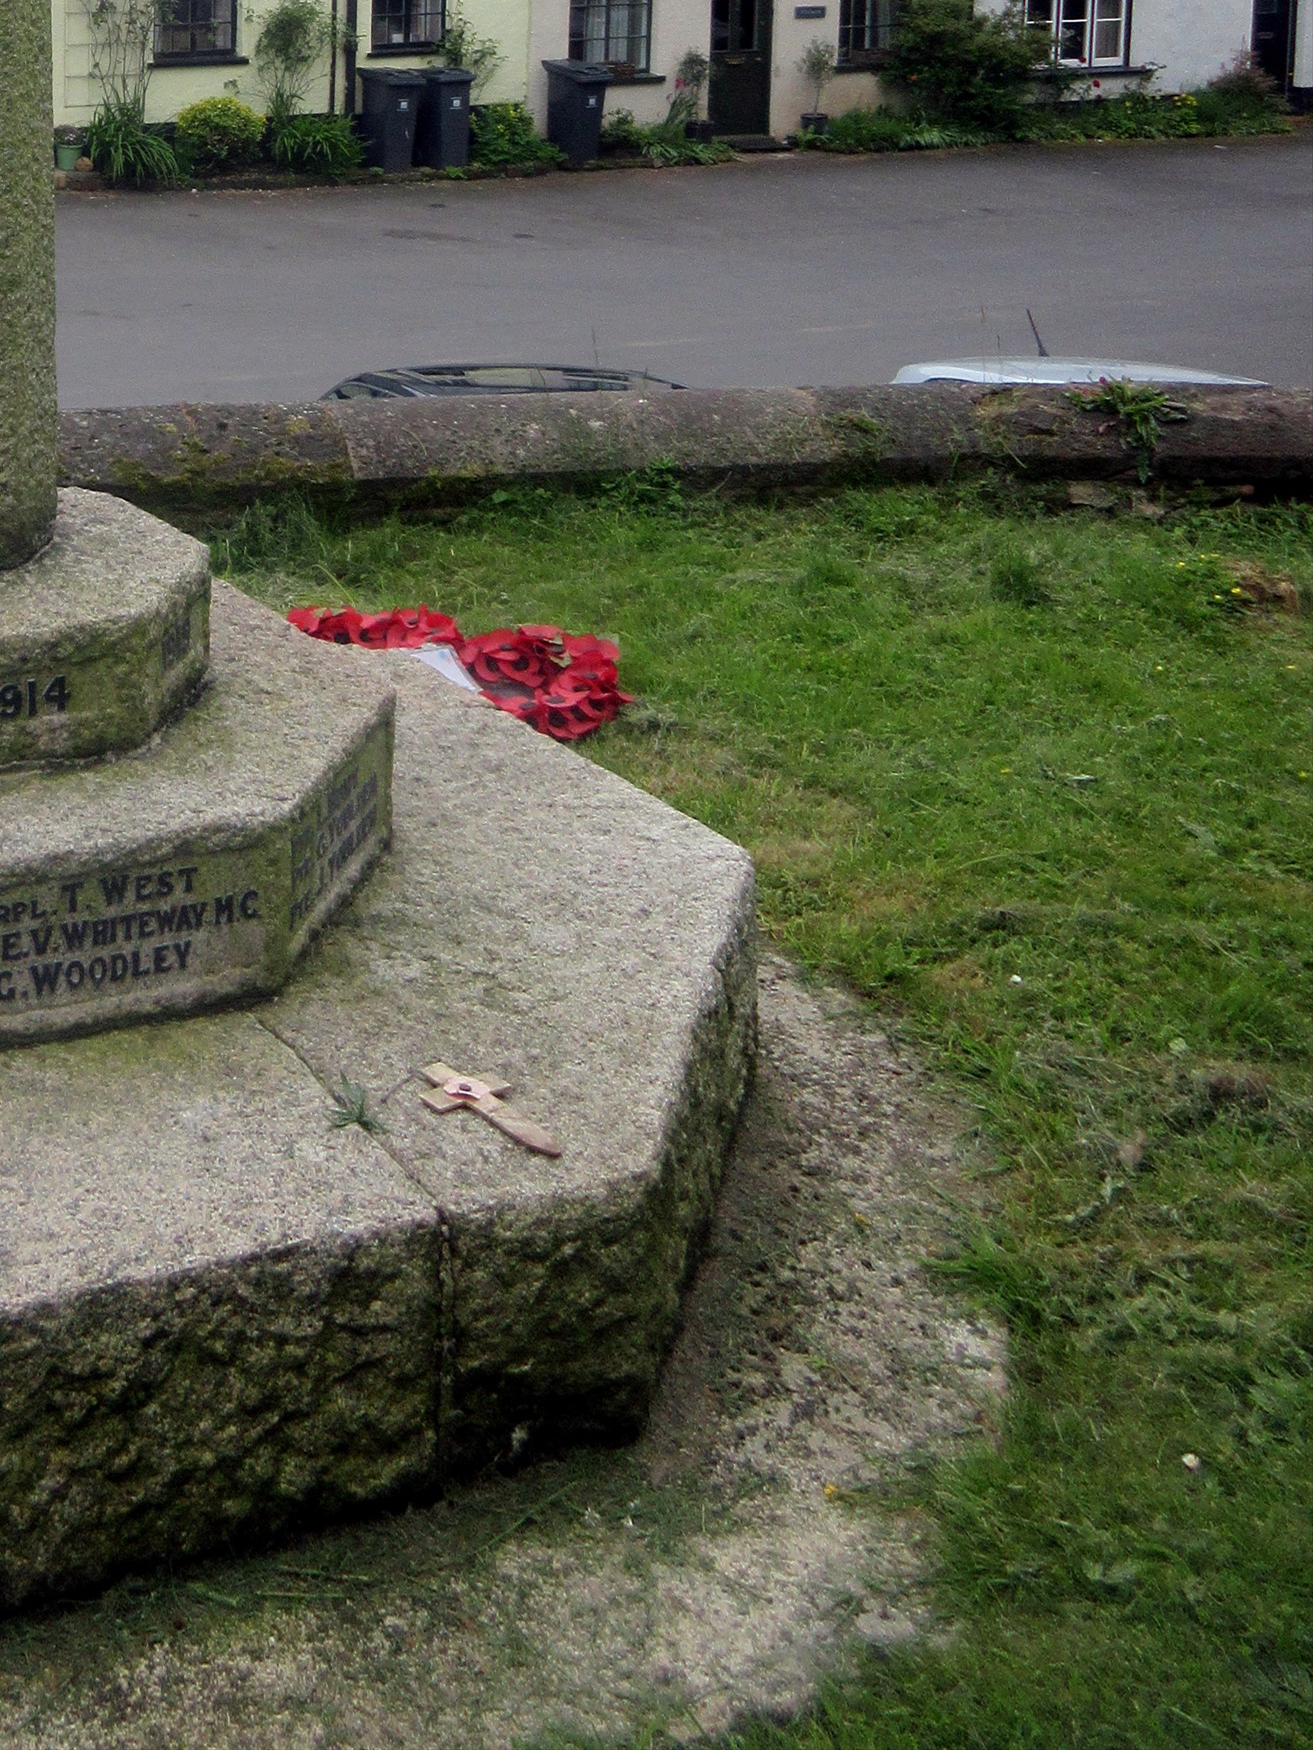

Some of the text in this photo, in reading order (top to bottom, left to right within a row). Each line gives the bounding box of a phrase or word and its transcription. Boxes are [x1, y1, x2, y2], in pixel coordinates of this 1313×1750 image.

[99, 865, 198, 906] WEST
[59, 901, 208, 952] WHITEWAY
[29, 940, 192, 998] WOODLEY
